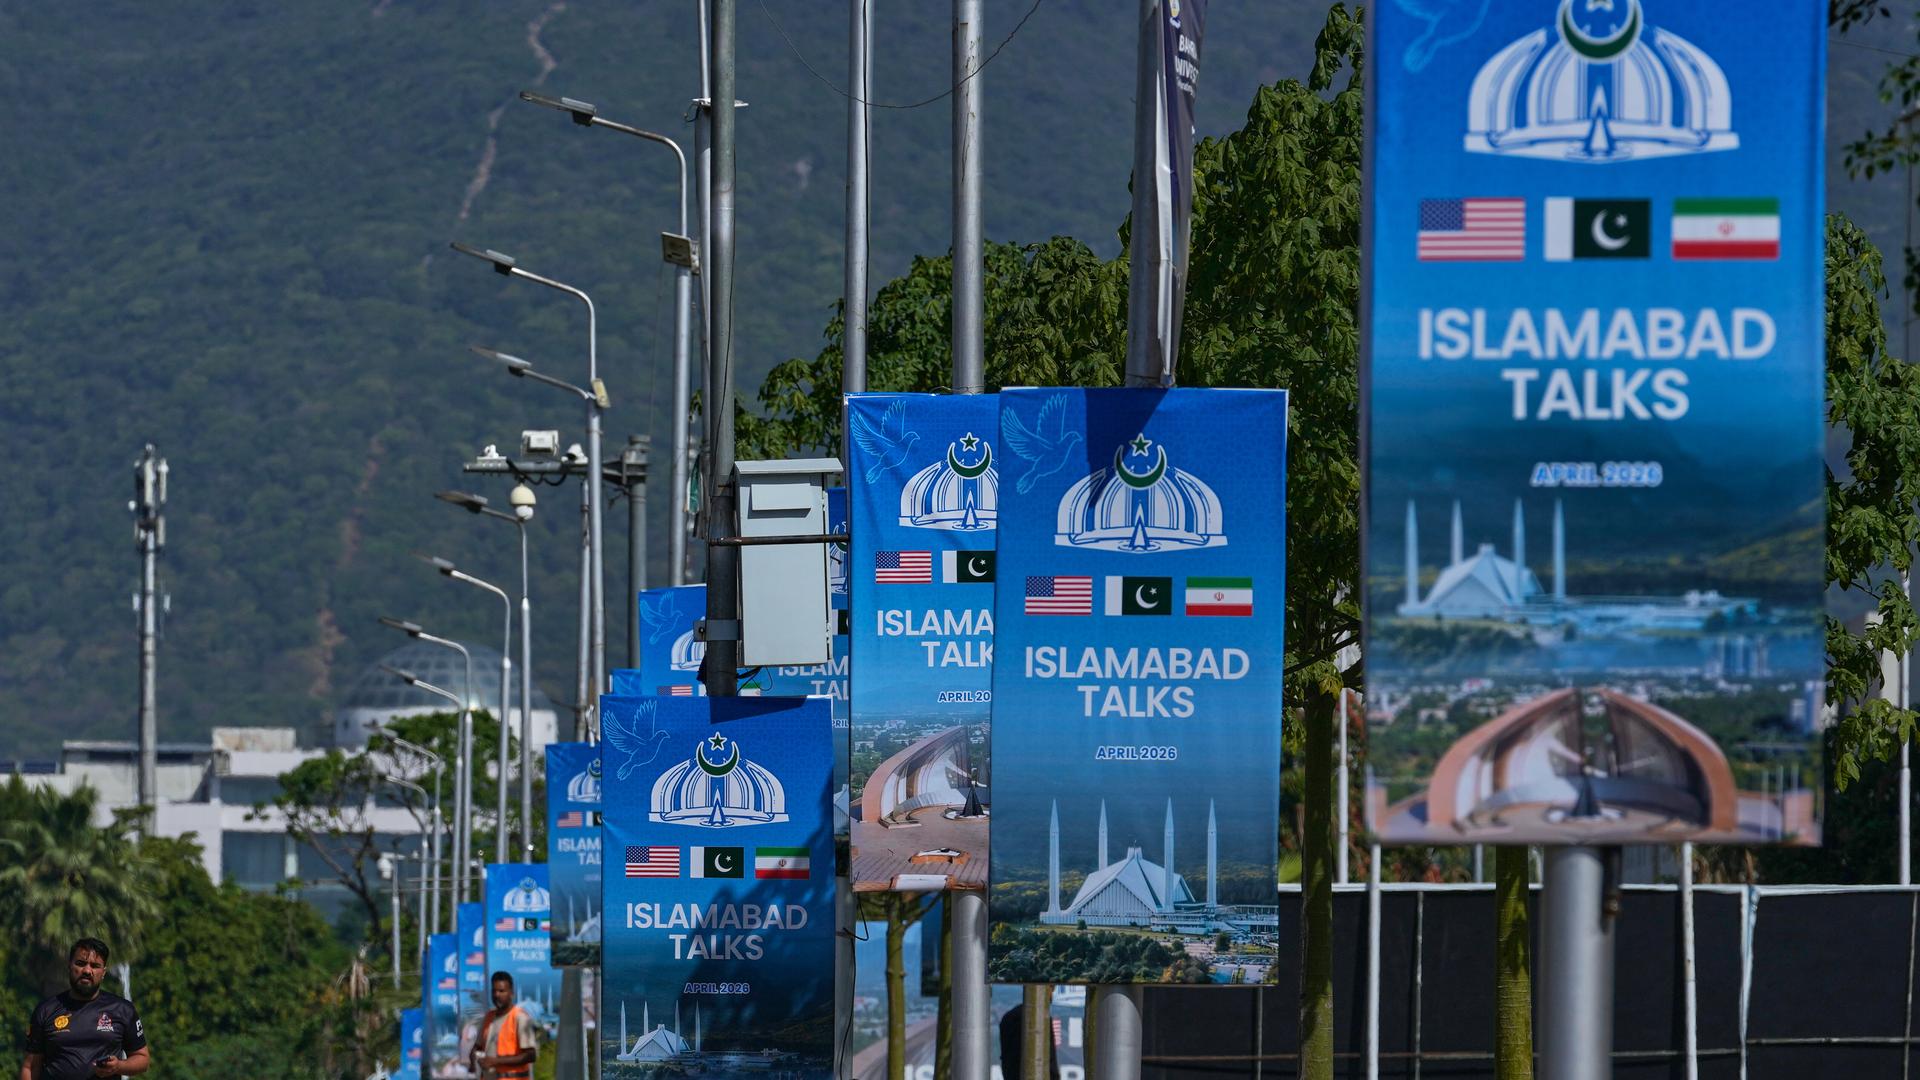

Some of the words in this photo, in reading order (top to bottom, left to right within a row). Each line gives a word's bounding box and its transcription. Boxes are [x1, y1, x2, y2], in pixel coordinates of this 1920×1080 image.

[1418, 308, 1777, 360] ISLAMABAD
[1502, 368, 1690, 420] TALKS
[1530, 461, 1600, 487] APRIL
[1601, 461, 1663, 487] 2026
[1025, 646, 1251, 680] ISLAMABAD
[938, 691, 973, 704] APRIL
[1077, 685, 1196, 718] TALKS
[1095, 745, 1138, 760] APRIL
[1139, 745, 1178, 760] 2026
[626, 902, 808, 930] ISLAMABAD
[669, 934, 764, 960] TALKS
[684, 982, 718, 994] APRIL
[719, 982, 750, 994] 2026
